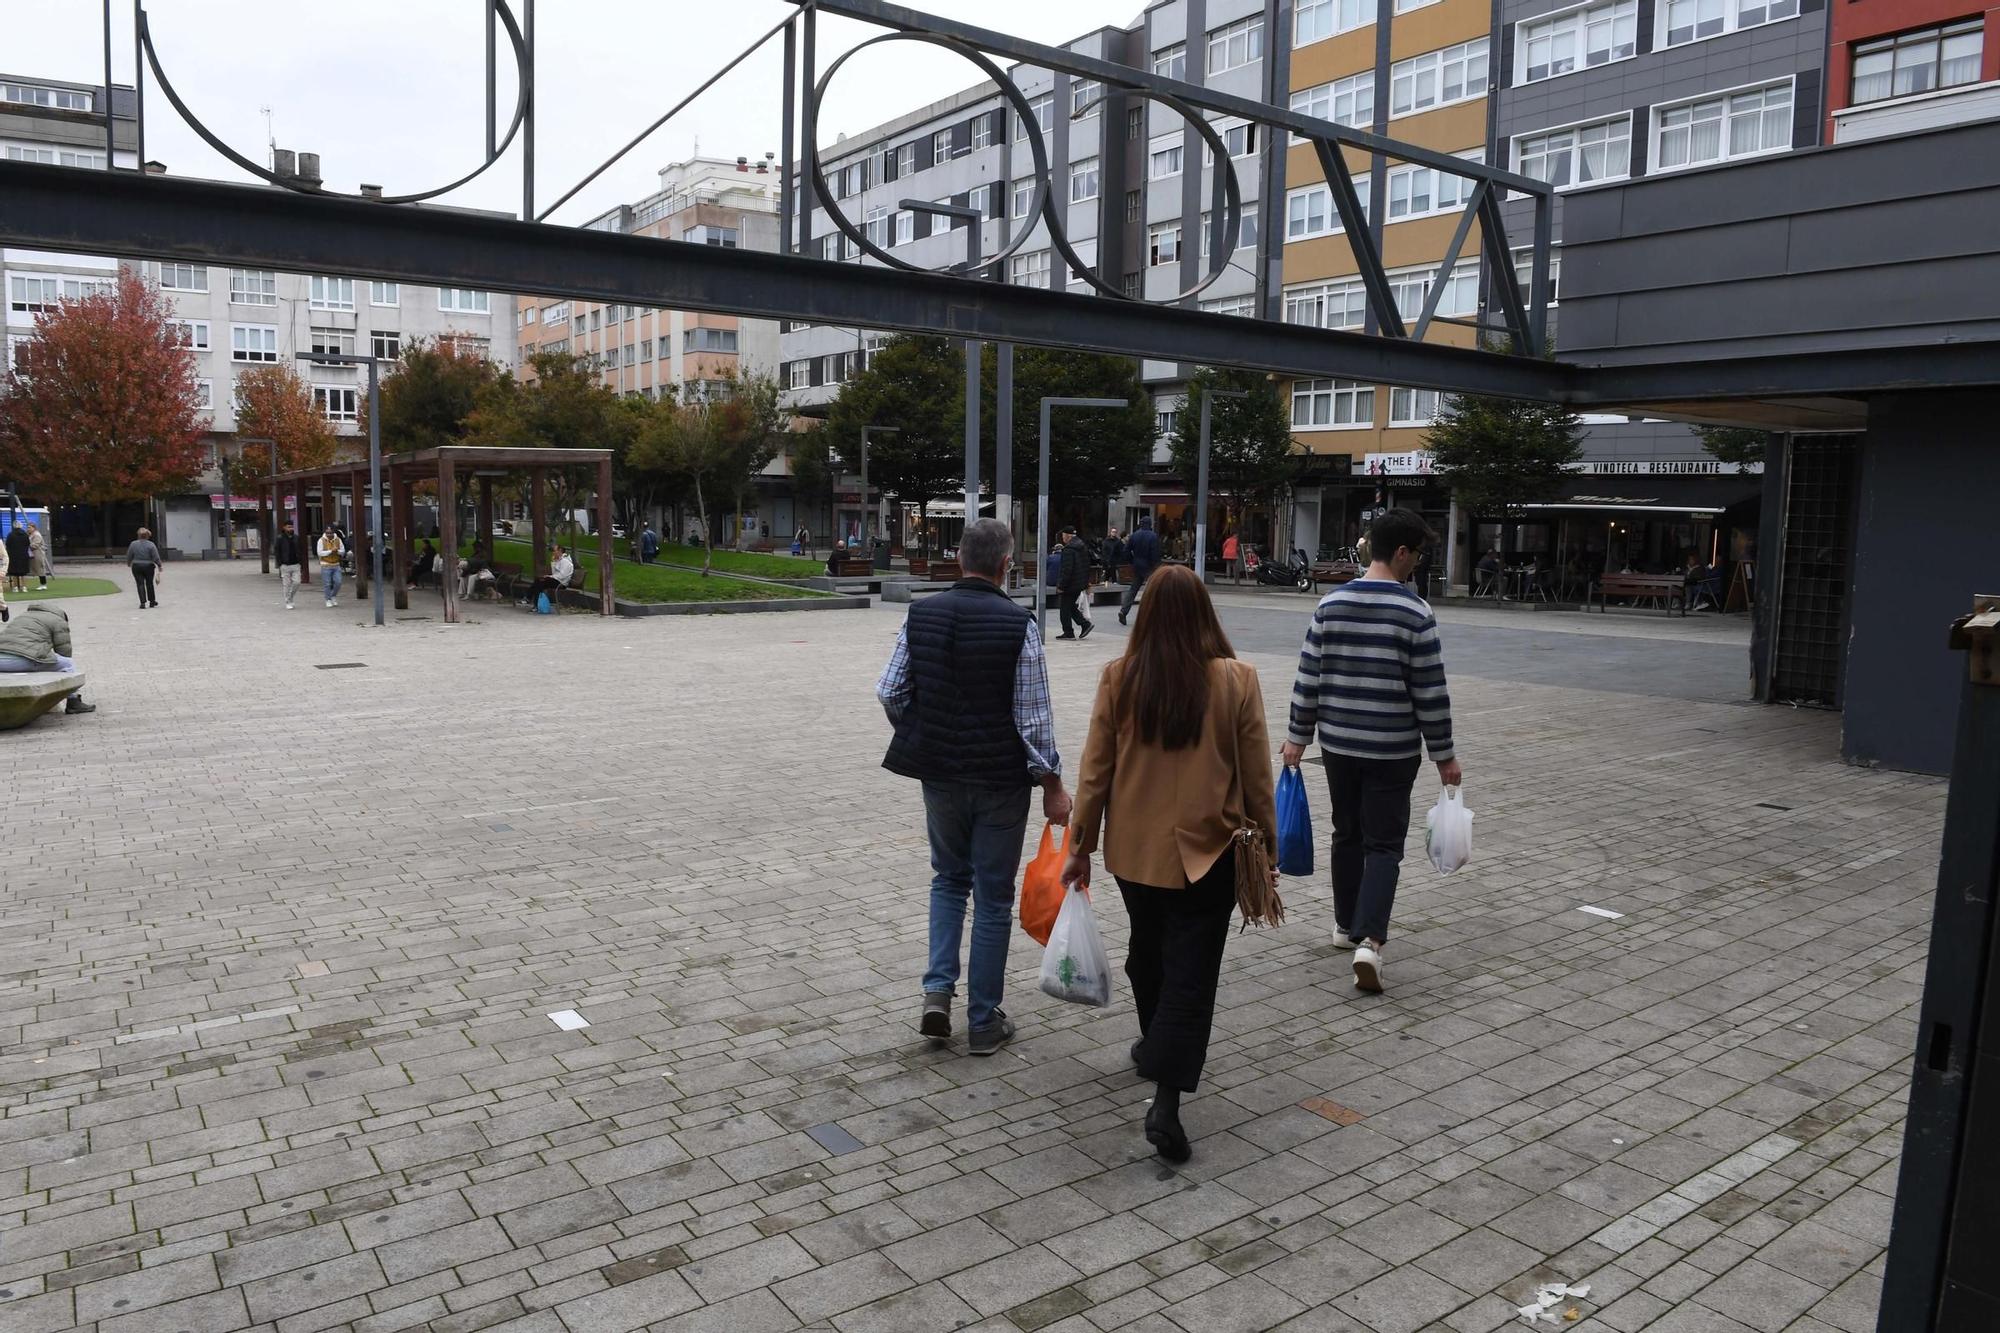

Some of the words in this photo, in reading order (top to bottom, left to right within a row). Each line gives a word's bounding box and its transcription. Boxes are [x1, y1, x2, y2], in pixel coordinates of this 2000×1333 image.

[1387, 456, 1404, 466] THE
[1593, 462, 1639, 473] VINOTECA
[1650, 462, 1720, 473] RESTAURANTE
[1386, 478, 1426, 487] GIMNASIO
